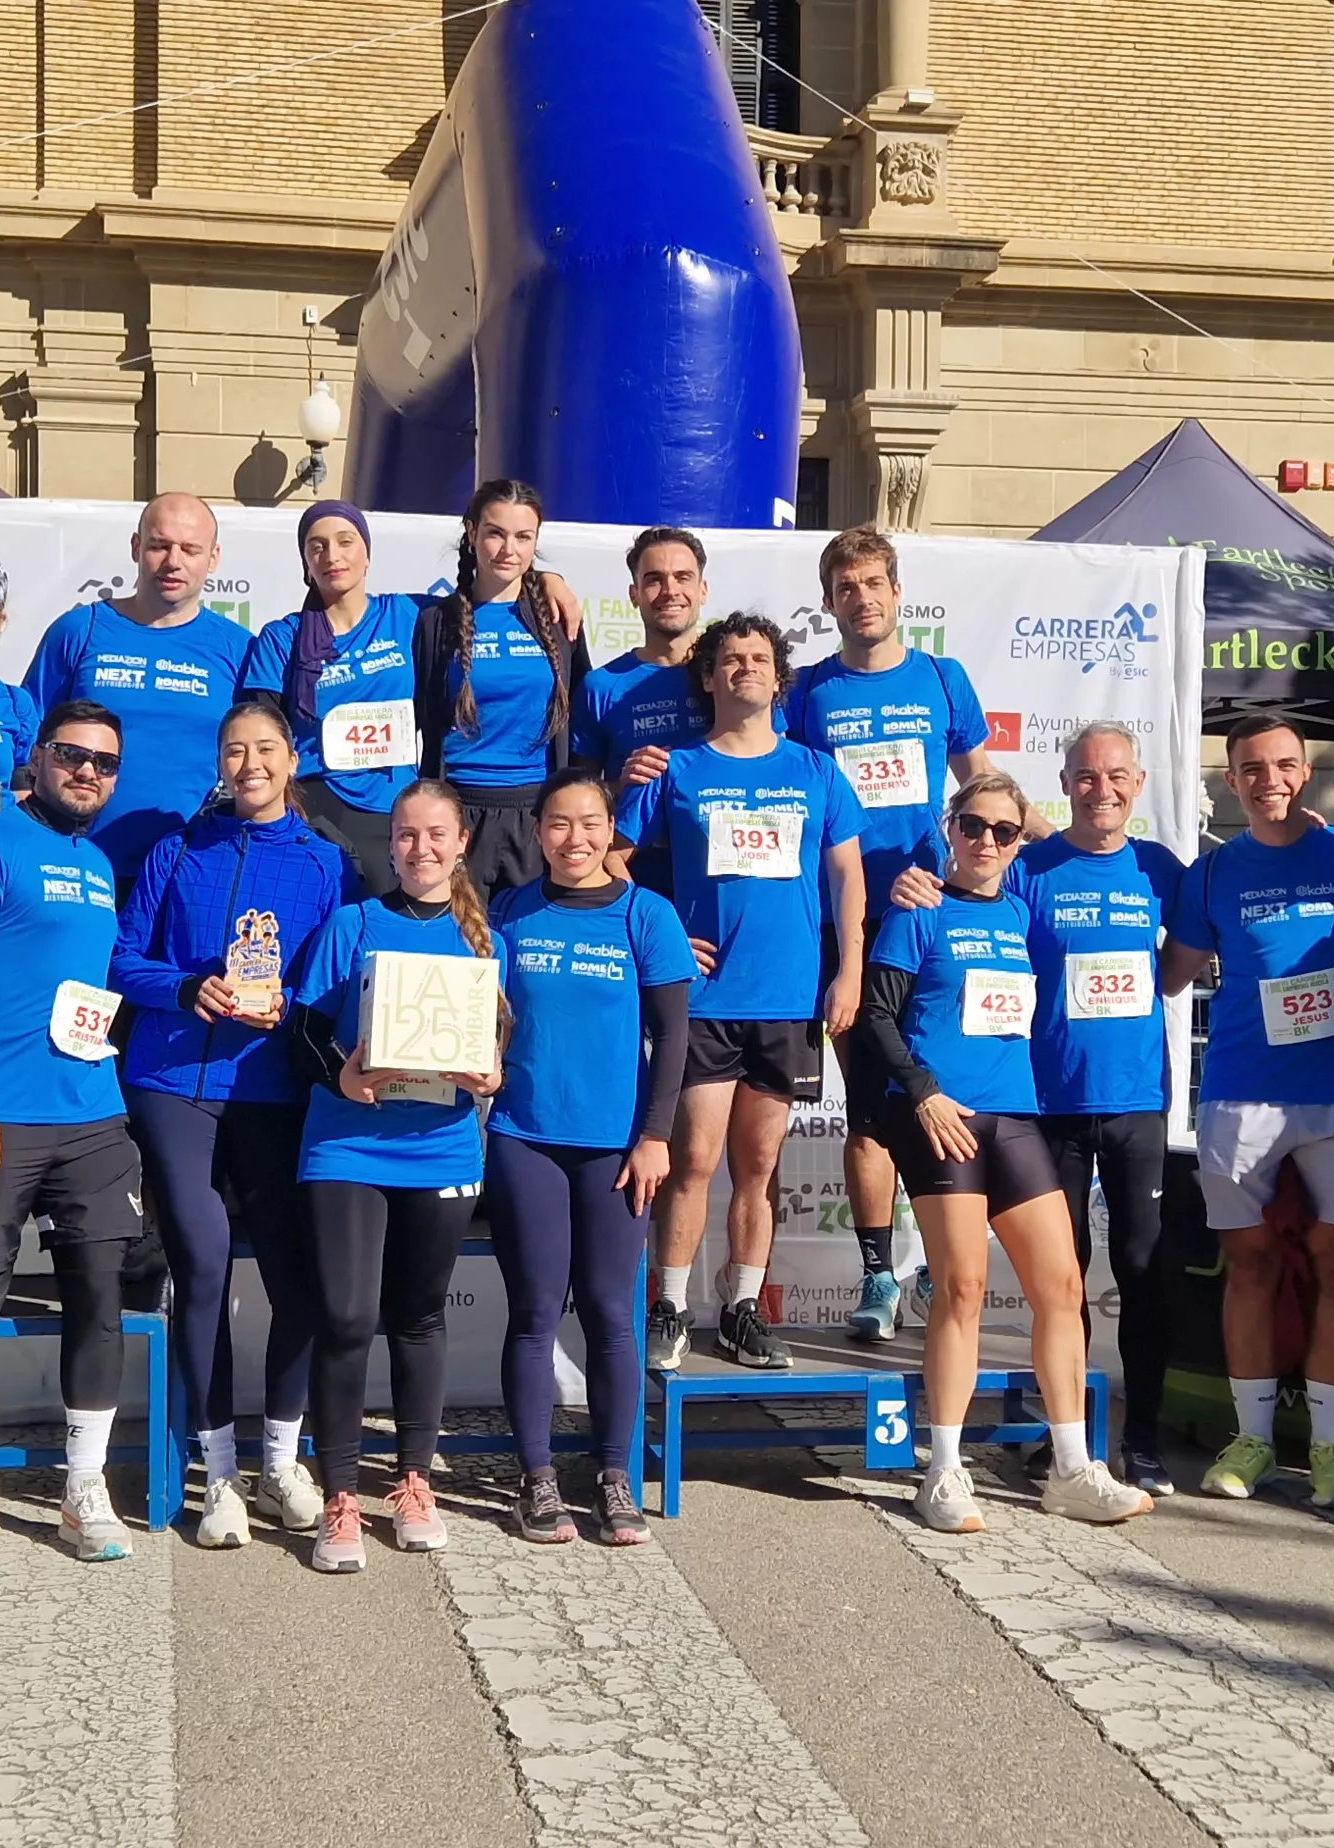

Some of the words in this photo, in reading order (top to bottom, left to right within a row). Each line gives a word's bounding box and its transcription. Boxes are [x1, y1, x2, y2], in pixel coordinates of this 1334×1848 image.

[1015, 616, 1133, 640] CARRERA
[1010, 640, 1136, 663] EMPRESAS
[95, 668, 146, 682] NEXT
[168, 660, 209, 678] kablex
[321, 664, 351, 681] EXT
[1110, 666, 1122, 679] By
[893, 703, 931, 715] kablex
[633, 713, 678, 731] NEXT
[827, 720, 872, 736] NEXT
[345, 723, 392, 744] 421
[353, 746, 388, 756] RIHAB
[1025, 736, 1048, 753] de
[353, 757, 369, 766] 8K
[858, 759, 906, 781] 333
[767, 787, 807, 799] kablex
[857, 780, 910, 792] ROBERTO
[867, 792, 883, 801] 8K
[733, 829, 779, 849] 393
[741, 851, 770, 860] JOSE
[44, 879, 82, 896] NEXT
[1240, 888, 1287, 900] MEDIAZION
[1054, 892, 1101, 903] MEDIAZION
[1054, 908, 1101, 921] NEXT
[1241, 902, 1287, 919] NEXT
[586, 943, 628, 959] kablex
[951, 942, 992, 954] NEXT
[516, 953, 562, 967] NEXT
[238, 961, 279, 977] EMPRESAS
[1089, 974, 1135, 995] 332
[980, 993, 1023, 1013] 423
[1088, 995, 1137, 1006] ENRIQUE
[1283, 989, 1333, 1015] 523
[1096, 1006, 1112, 1015] 8K
[74, 1006, 111, 1035] 531
[466, 986, 484, 1064] AMBAR
[986, 1015, 1022, 1024] HELEN
[1292, 1012, 1329, 1026] JESUS
[69, 1029, 103, 1046] CRISTIA
[1293, 1025, 1311, 1036] 8K
[389, 1083, 406, 1093] 8K
[788, 1307, 809, 1324] de
[874, 1400, 908, 1445] 3
